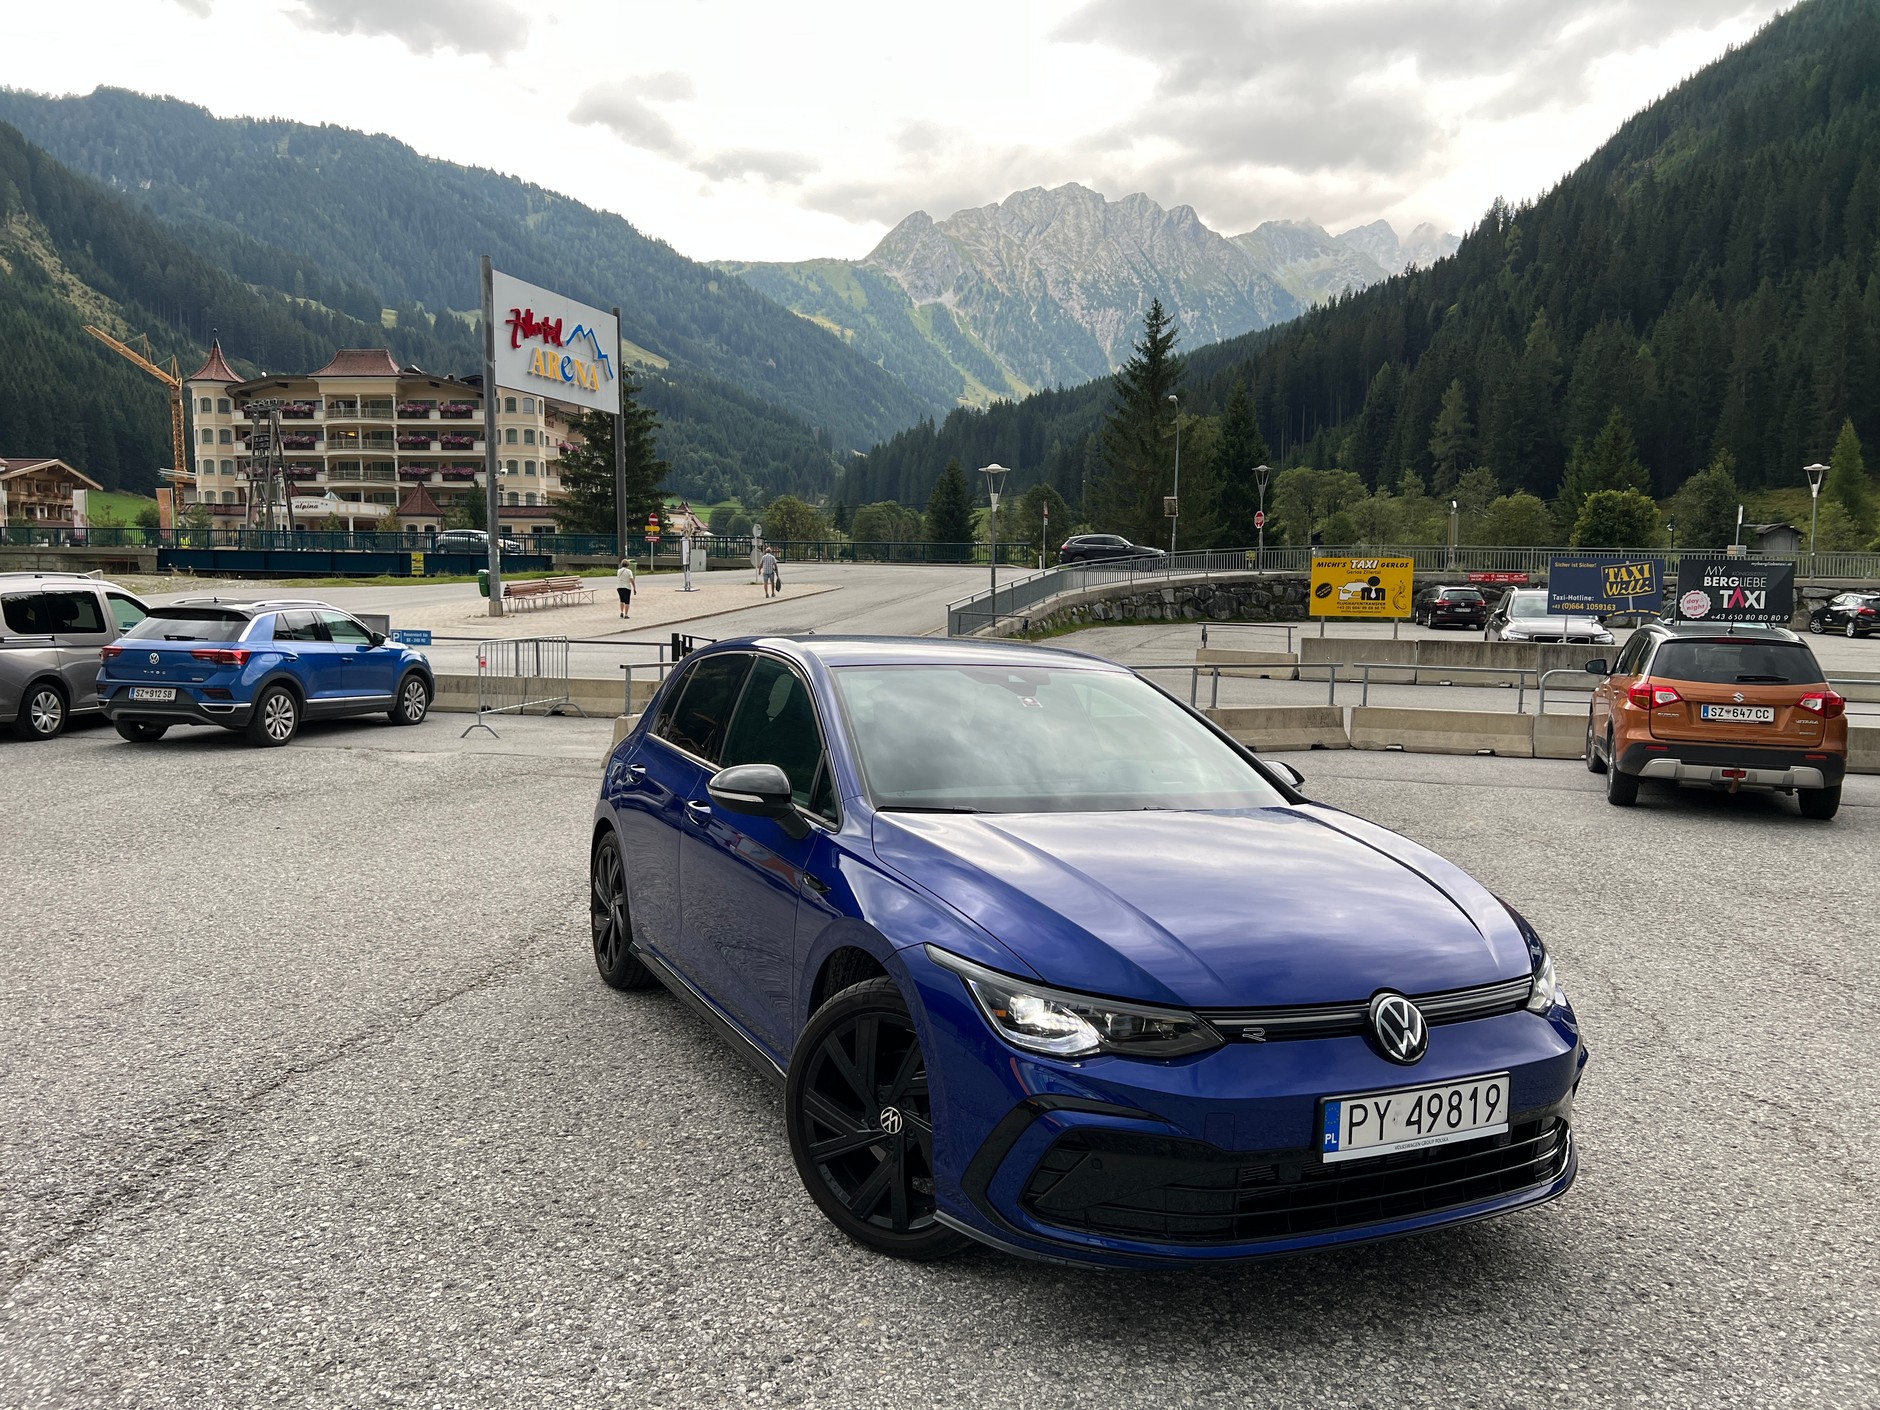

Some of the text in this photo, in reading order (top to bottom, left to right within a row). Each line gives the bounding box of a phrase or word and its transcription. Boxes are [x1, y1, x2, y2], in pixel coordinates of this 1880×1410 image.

[1350, 559, 1380, 570] TAXI
[1704, 565, 1726, 575] MY
[1605, 563, 1651, 582] TAXI
[1606, 579, 1652, 596] Willi
[1703, 576, 1767, 588] BERGLIEBE
[1719, 586, 1766, 609] TAXI
[1586, 603, 1616, 611] 1059163
[392, 632, 400, 642] P
[135, 689, 172, 698] SZ 912 SB
[1711, 707, 1725, 717] SZ
[1732, 708, 1753, 718] 647
[1755, 709, 1769, 719] CC
[1348, 1084, 1500, 1145] PY 49819
[1324, 1133, 1337, 1145] PL
